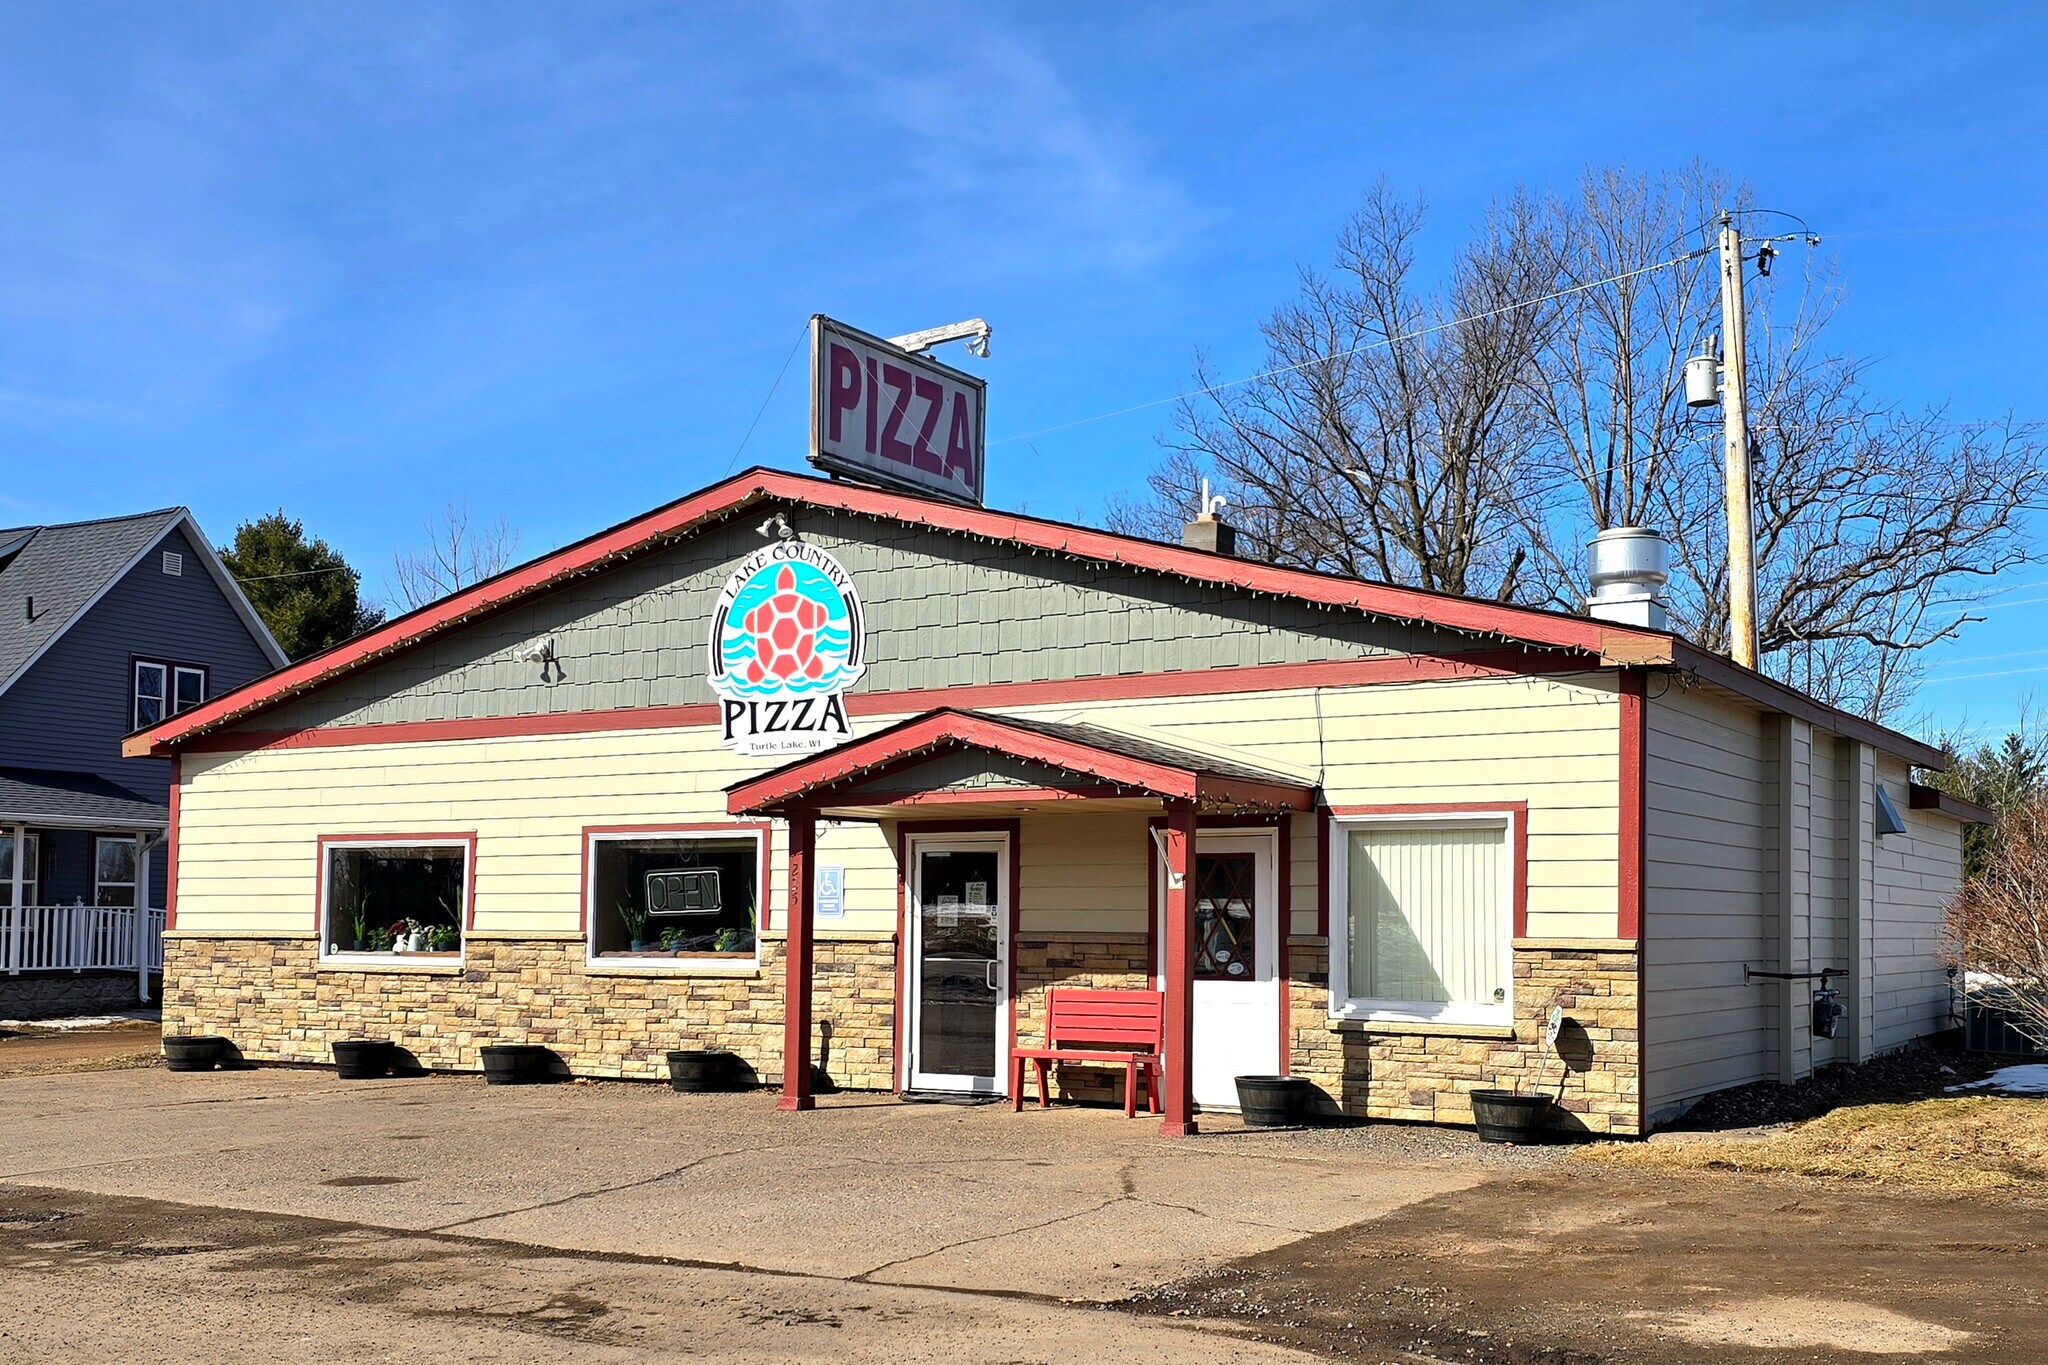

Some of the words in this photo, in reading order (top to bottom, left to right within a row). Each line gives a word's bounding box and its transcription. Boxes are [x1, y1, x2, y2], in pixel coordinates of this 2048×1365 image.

[829, 342, 974, 488] PIZZA
[725, 552, 767, 599] LAKE
[772, 545, 849, 587] COUNTRY
[723, 694, 848, 740] PIZZA
[750, 742, 778, 751] Turtle
[781, 741, 807, 749] Lake,
[809, 739, 821, 747] WI
[650, 875, 718, 910] OPEN
